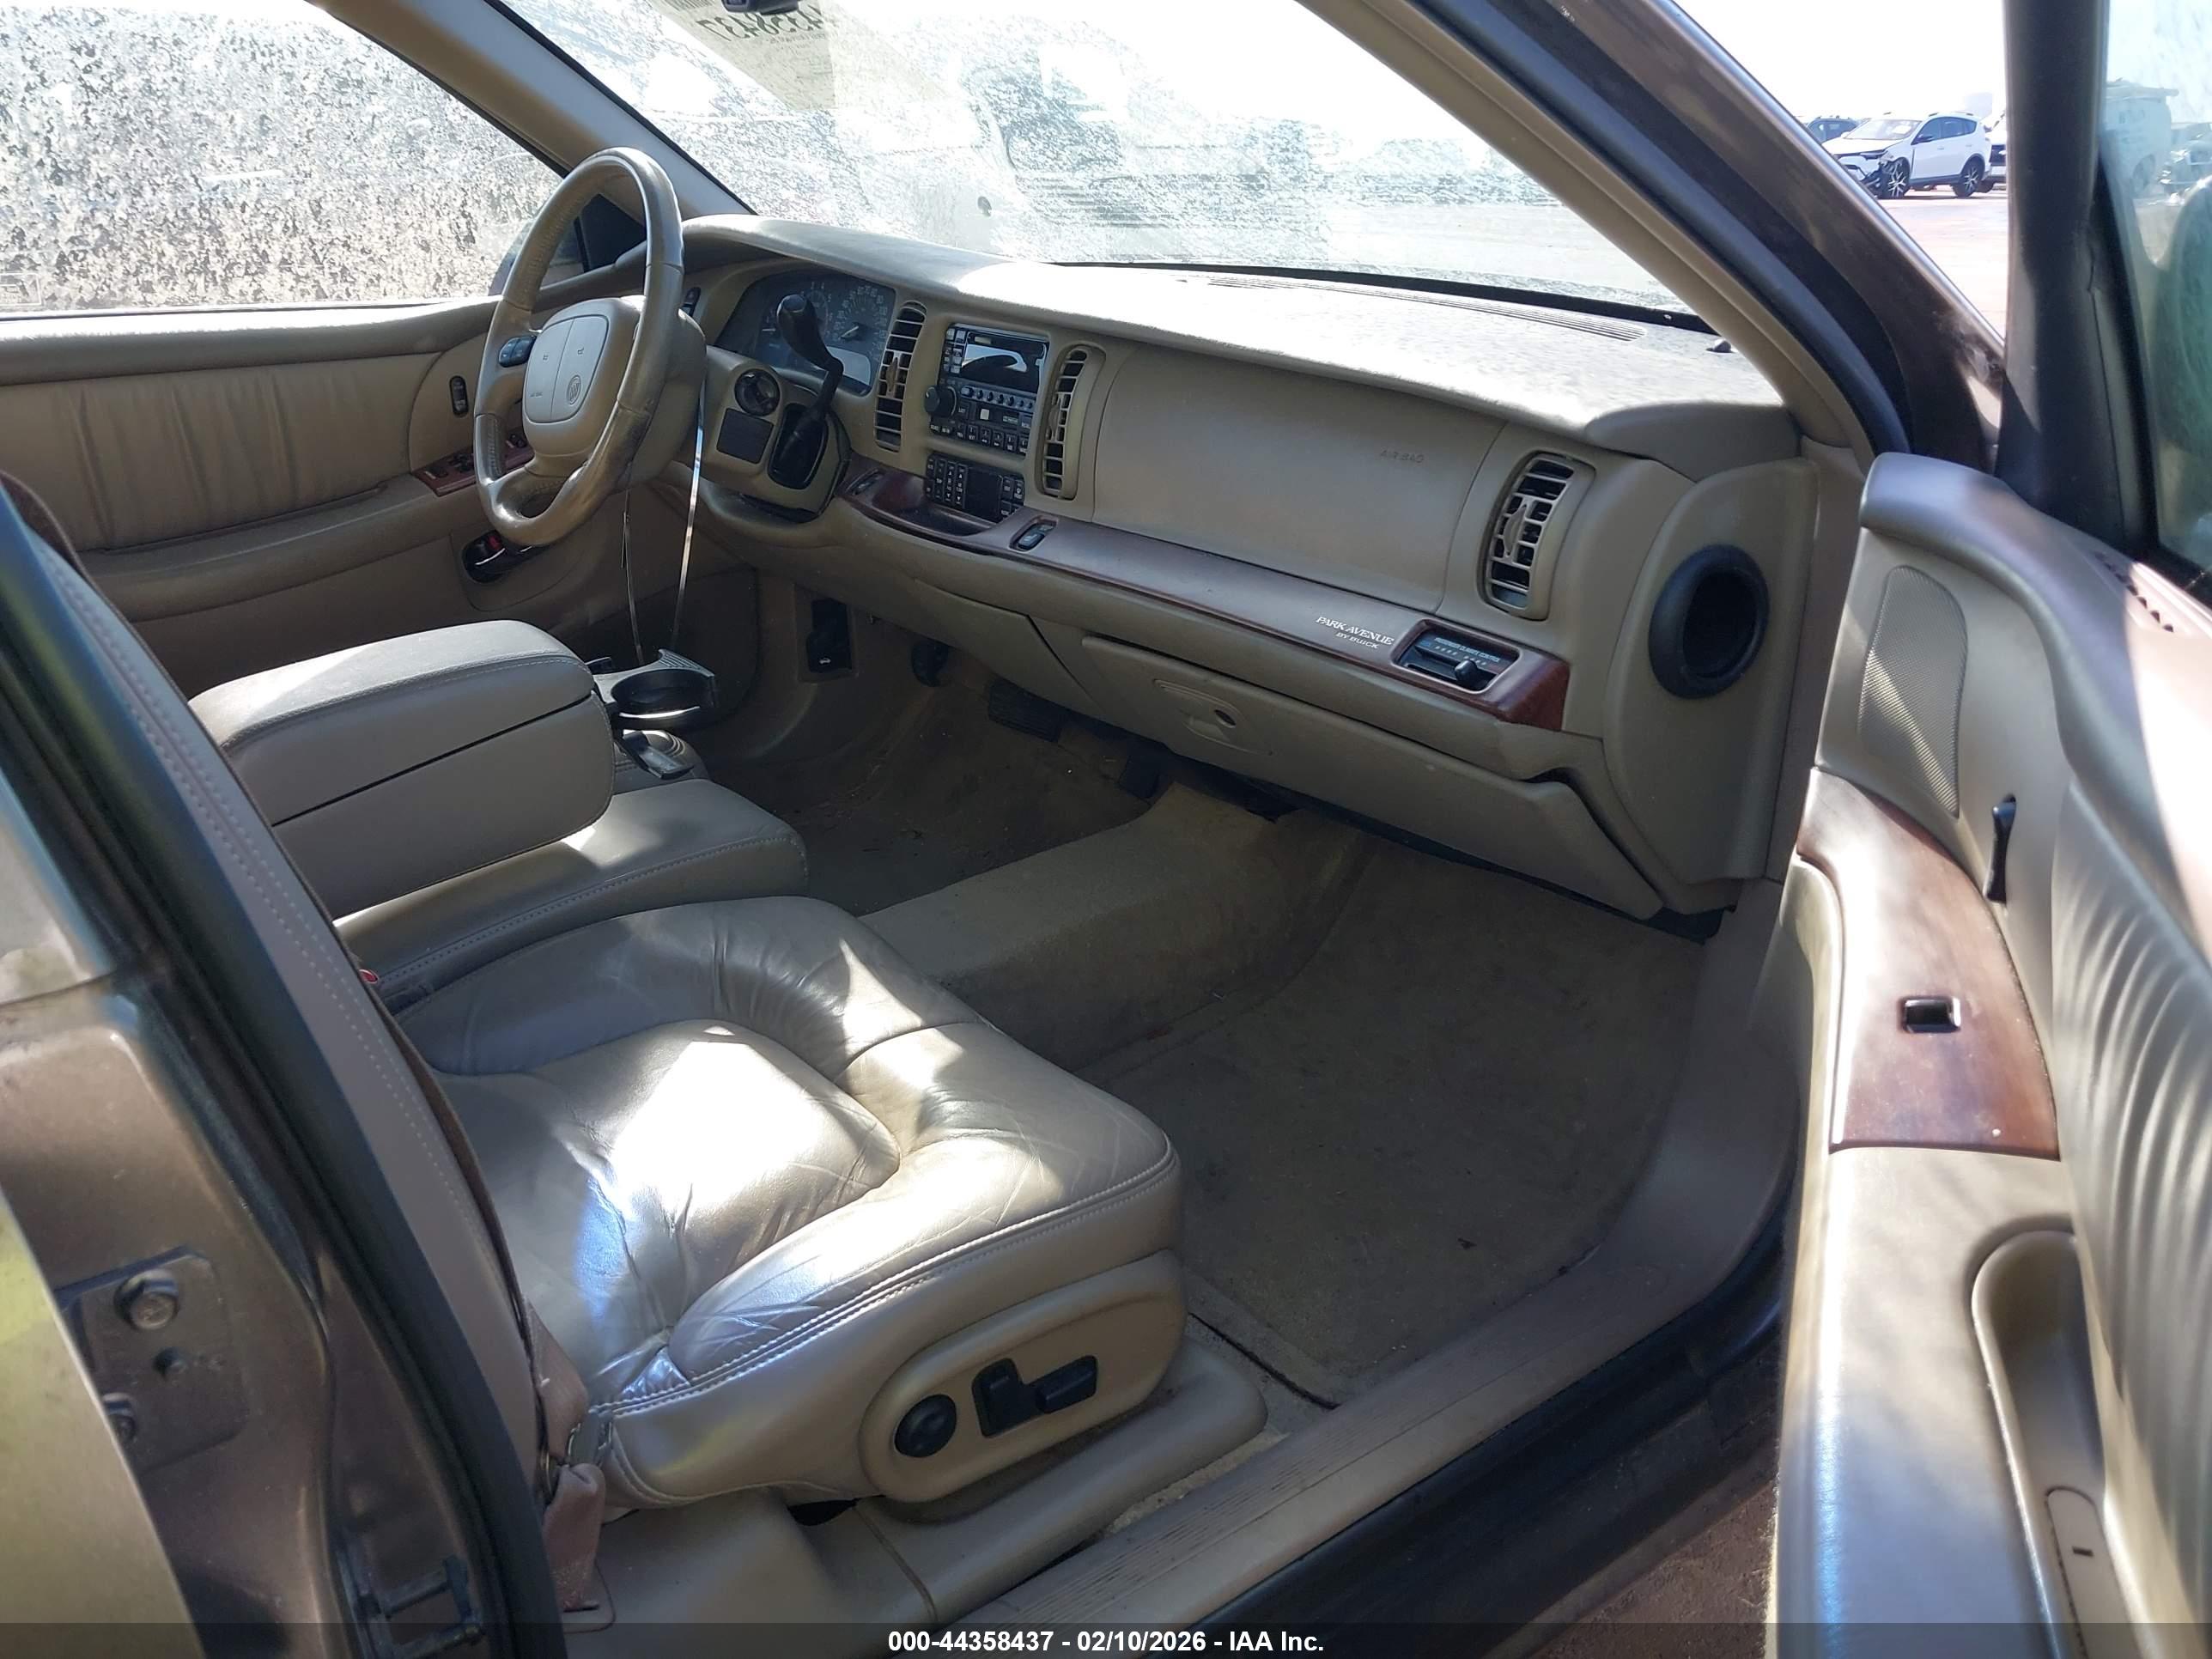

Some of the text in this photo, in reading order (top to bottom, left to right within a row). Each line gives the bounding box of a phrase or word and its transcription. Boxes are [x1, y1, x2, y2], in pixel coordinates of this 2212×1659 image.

[1316, 617, 1395, 645] PARK AVENUE
[1349, 636, 1380, 649] BUICK
